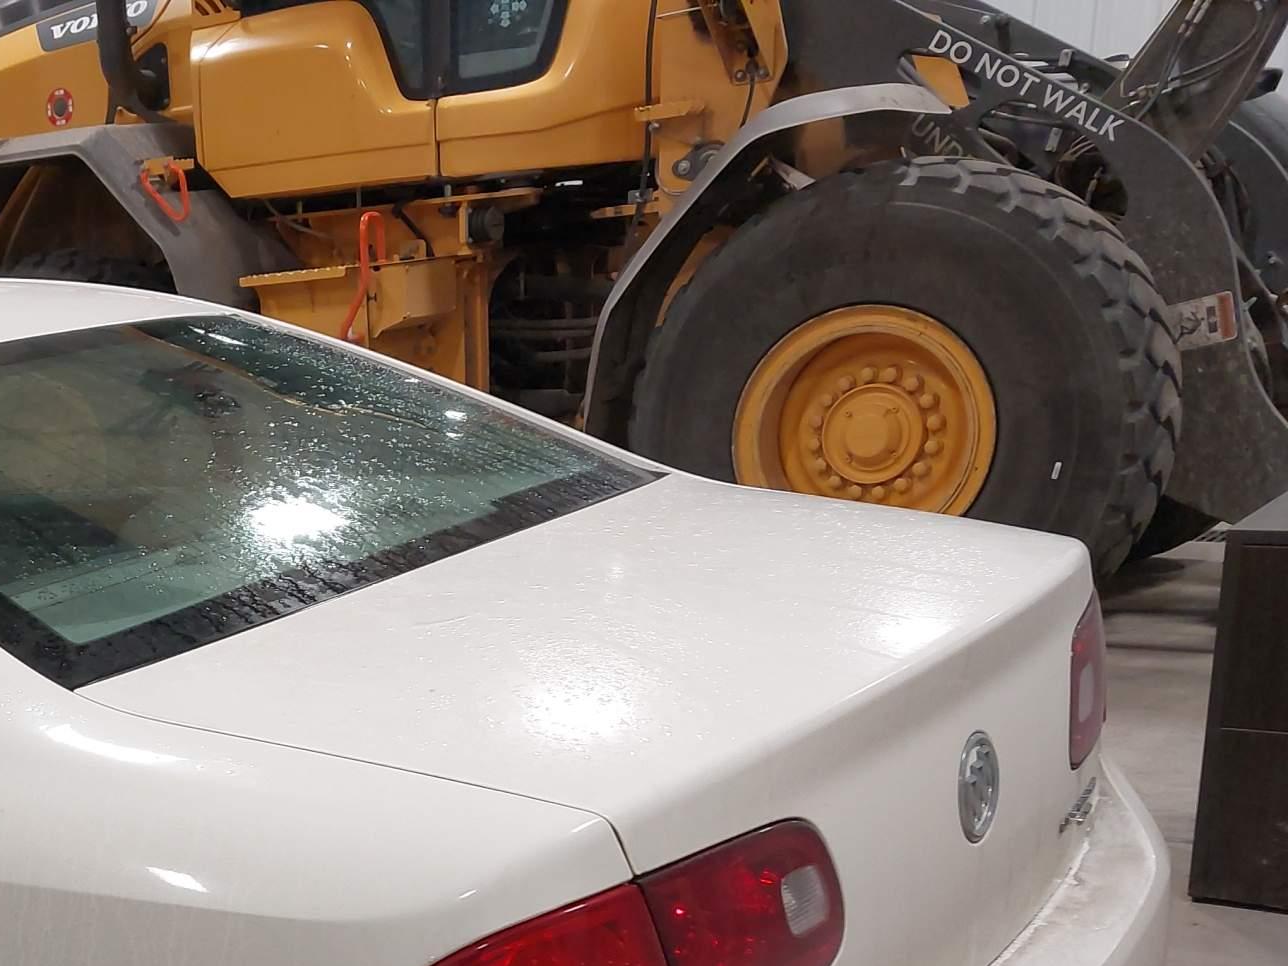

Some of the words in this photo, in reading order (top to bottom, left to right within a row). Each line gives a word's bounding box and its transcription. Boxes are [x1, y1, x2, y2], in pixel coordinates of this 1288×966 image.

[928, 30, 973, 64] DO
[974, 52, 1040, 96] NOT
[1042, 84, 1125, 142] WALK
